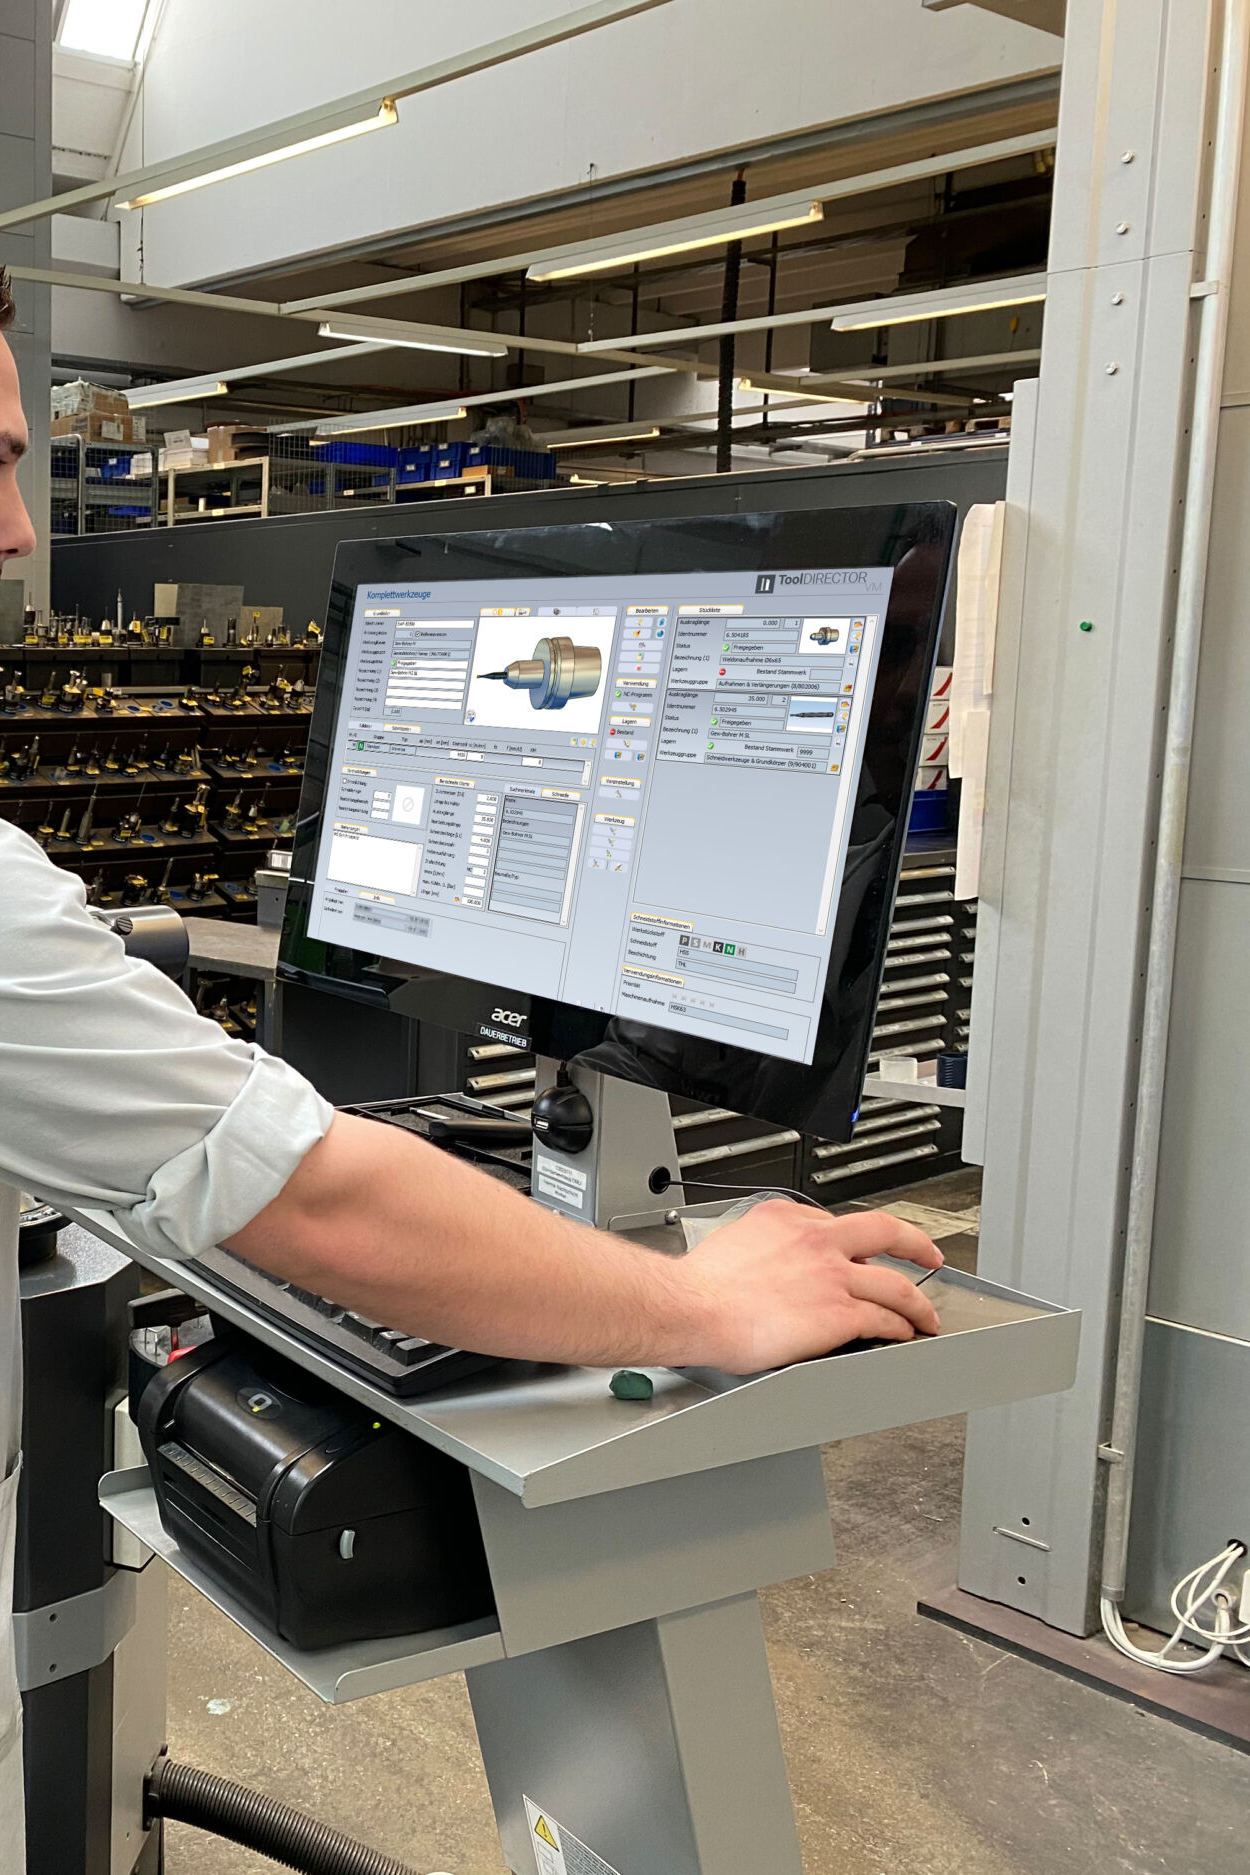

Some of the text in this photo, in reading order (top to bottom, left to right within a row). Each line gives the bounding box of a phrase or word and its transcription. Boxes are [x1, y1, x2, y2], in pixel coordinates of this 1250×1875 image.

[777, 571, 868, 584] ToolDIRECTOR
[366, 588, 432, 601] Komplettwerkzeuge
[750, 681, 790, 689] Verlängerungen
[721, 719, 752, 727] Freigegeben
[662, 726, 689, 734] Bezeichnung
[709, 730, 738, 738] Gew-Bohrer
[658, 749, 696, 758] Werkzeuggruppe
[765, 745, 794, 753] Stammwerk
[799, 748, 813, 756] 9999
[706, 754, 750, 763] Schneidwerkzeuge
[755, 758, 786, 766] Grundkörper
[603, 816, 625, 824] Werkzeug
[629, 937, 657, 948] Schneidstoff
[627, 949, 656, 961] Beschichtung
[623, 966, 682, 986] Verwendungsinformationen
[621, 990, 665, 1007] Maschinenaufnahme
[491, 1007, 528, 1027] acer
[479, 1026, 527, 1047] DAUERBETRIEB
